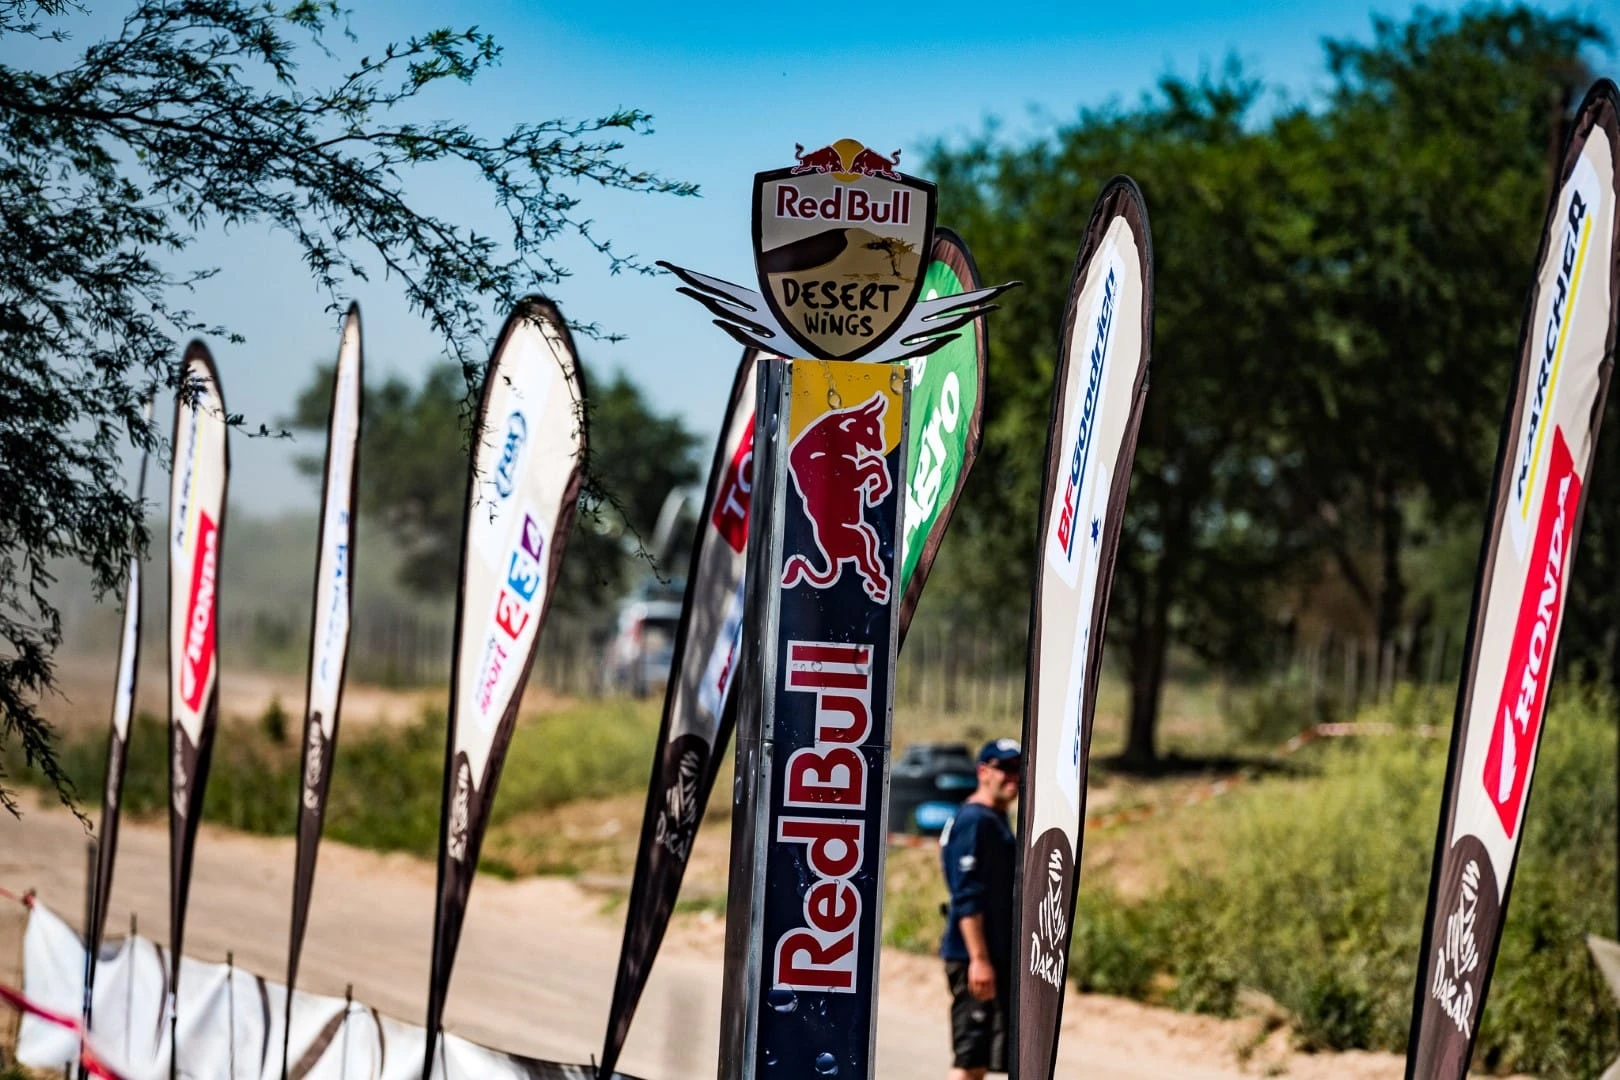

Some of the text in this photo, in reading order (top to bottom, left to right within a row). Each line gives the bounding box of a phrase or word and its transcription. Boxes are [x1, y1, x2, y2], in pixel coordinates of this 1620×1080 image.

[775, 184, 912, 225] Red Bull
[782, 278, 900, 313] DESERT
[1057, 266, 1115, 554] BFGoodrich
[1514, 472, 1573, 736] HONDA
[775, 641, 875, 993] Red Bull
[1029, 930, 1065, 993] DAKAR
[1431, 946, 1474, 1041] DAKAR
